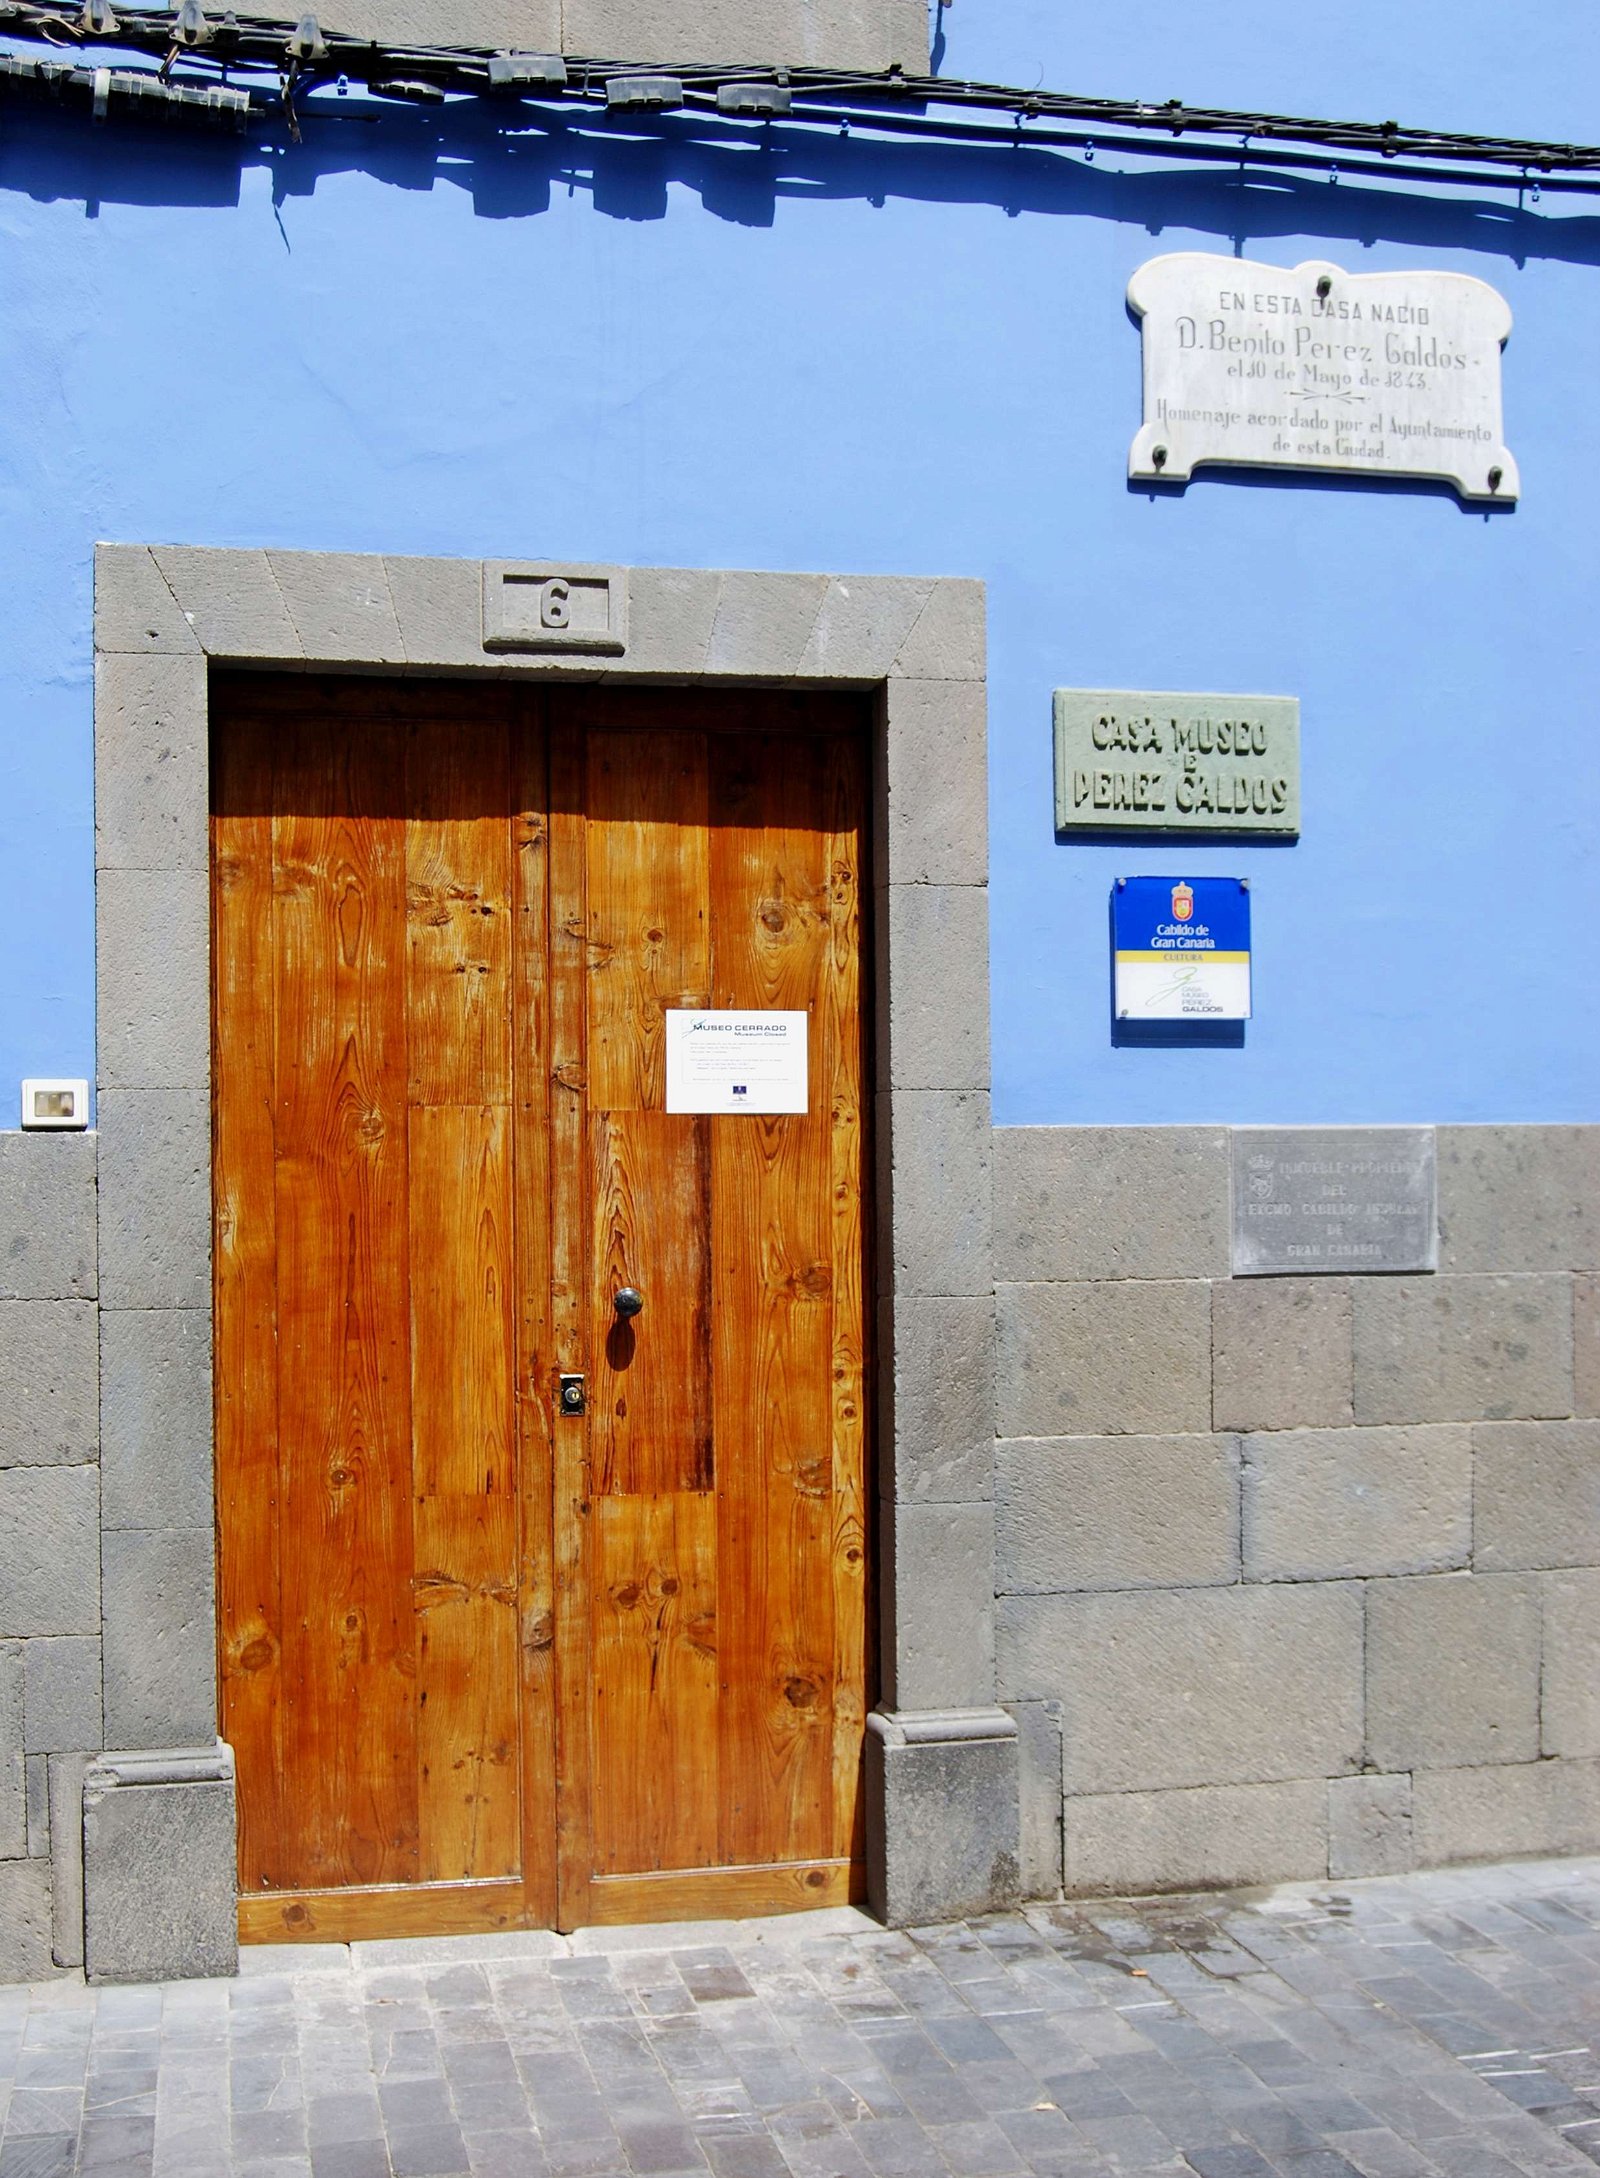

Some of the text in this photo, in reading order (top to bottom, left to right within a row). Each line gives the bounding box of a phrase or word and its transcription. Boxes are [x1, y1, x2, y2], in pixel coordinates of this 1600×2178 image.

[1219, 291, 1429, 326] EN ESTA CASA NACIO
[1175, 316, 1204, 349] D.
[1208, 319, 1286, 357] Benito
[1227, 359, 1243, 378] el
[1274, 361, 1296, 381] de
[1303, 363, 1352, 391] Mayo
[1359, 368, 1380, 387] de
[1156, 398, 1492, 444] Homenaje acordado por el Ayuntamiento
[1272, 433, 1291, 452] de
[1297, 440, 1331, 455] esta
[540, 577, 571, 628] 6
[1092, 712, 1268, 756] CASA MUSEO
[1073, 769, 1288, 815] PEREZ GALDOS
[1150, 936, 1216, 949] Gran Canaria
[1156, 924, 1210, 936] Cabildo de
[734, 1024, 787, 1032] CERRADO
